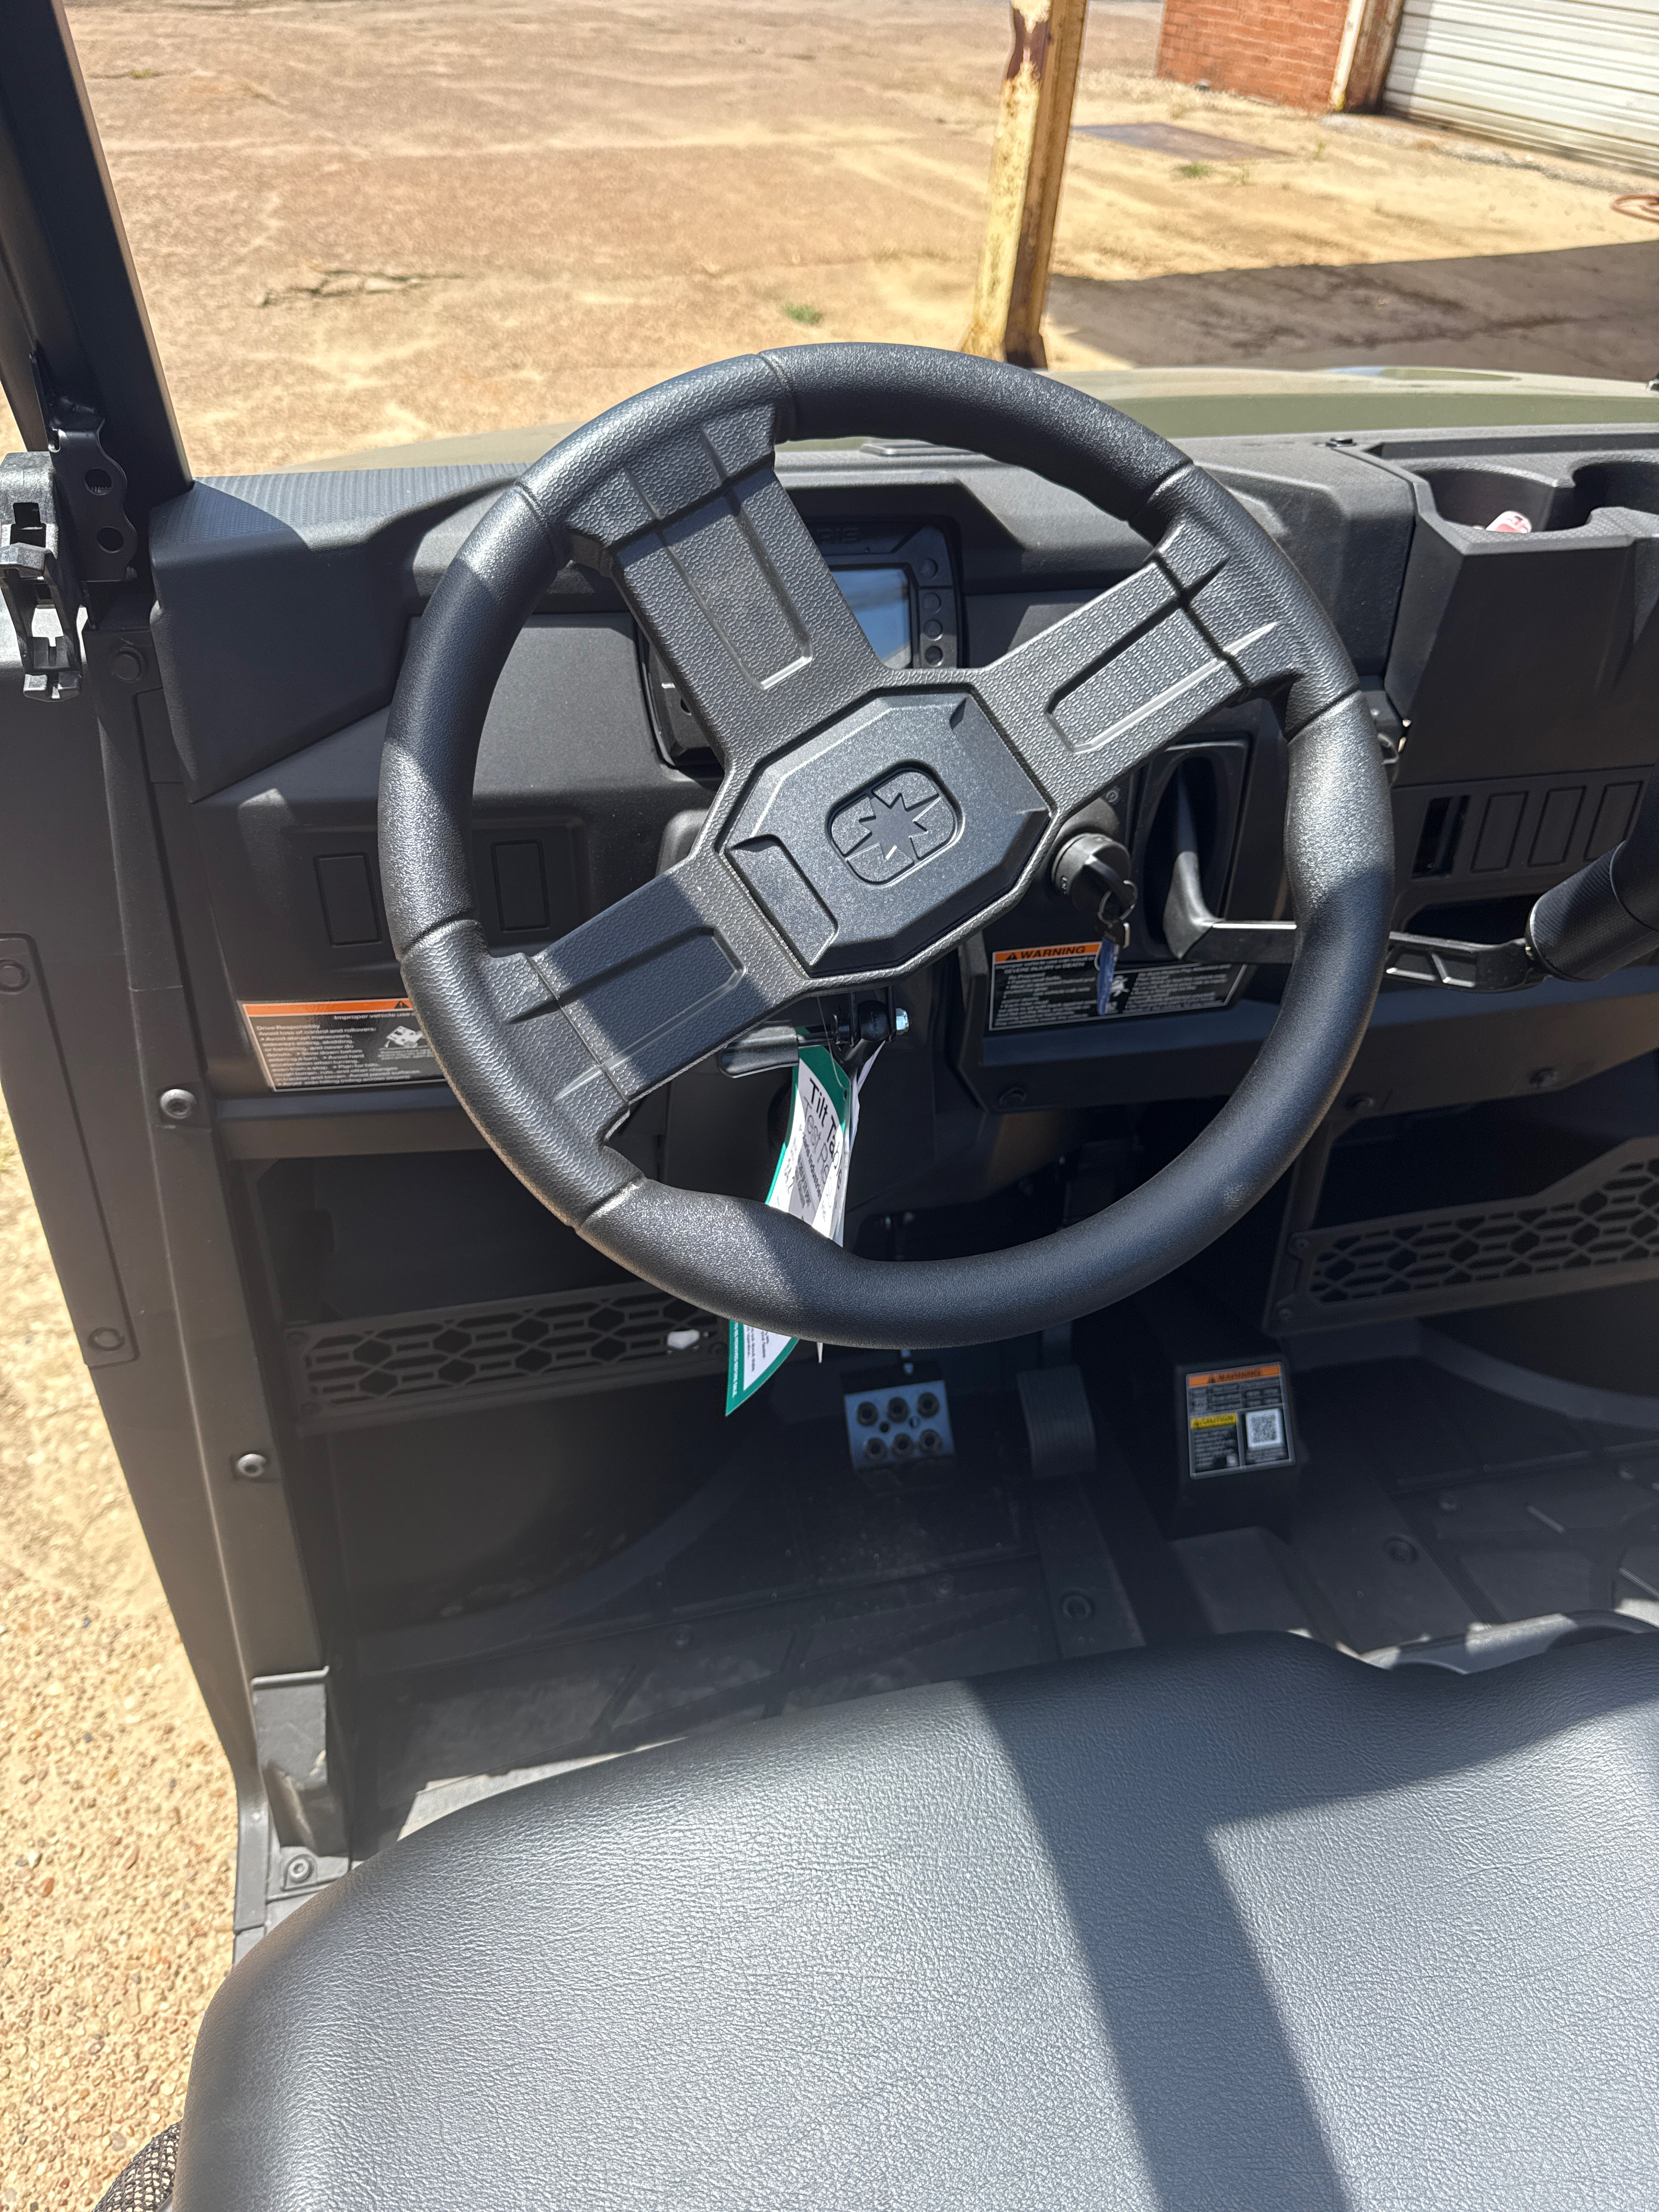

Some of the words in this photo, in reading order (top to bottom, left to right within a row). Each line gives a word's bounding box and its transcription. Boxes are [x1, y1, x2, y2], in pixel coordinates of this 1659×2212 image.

[1021, 947, 1086, 958] WARNING
[803, 1096, 821, 1154] Test
[809, 1077, 828, 1127] Tilt
[827, 1114, 842, 1190] Table
